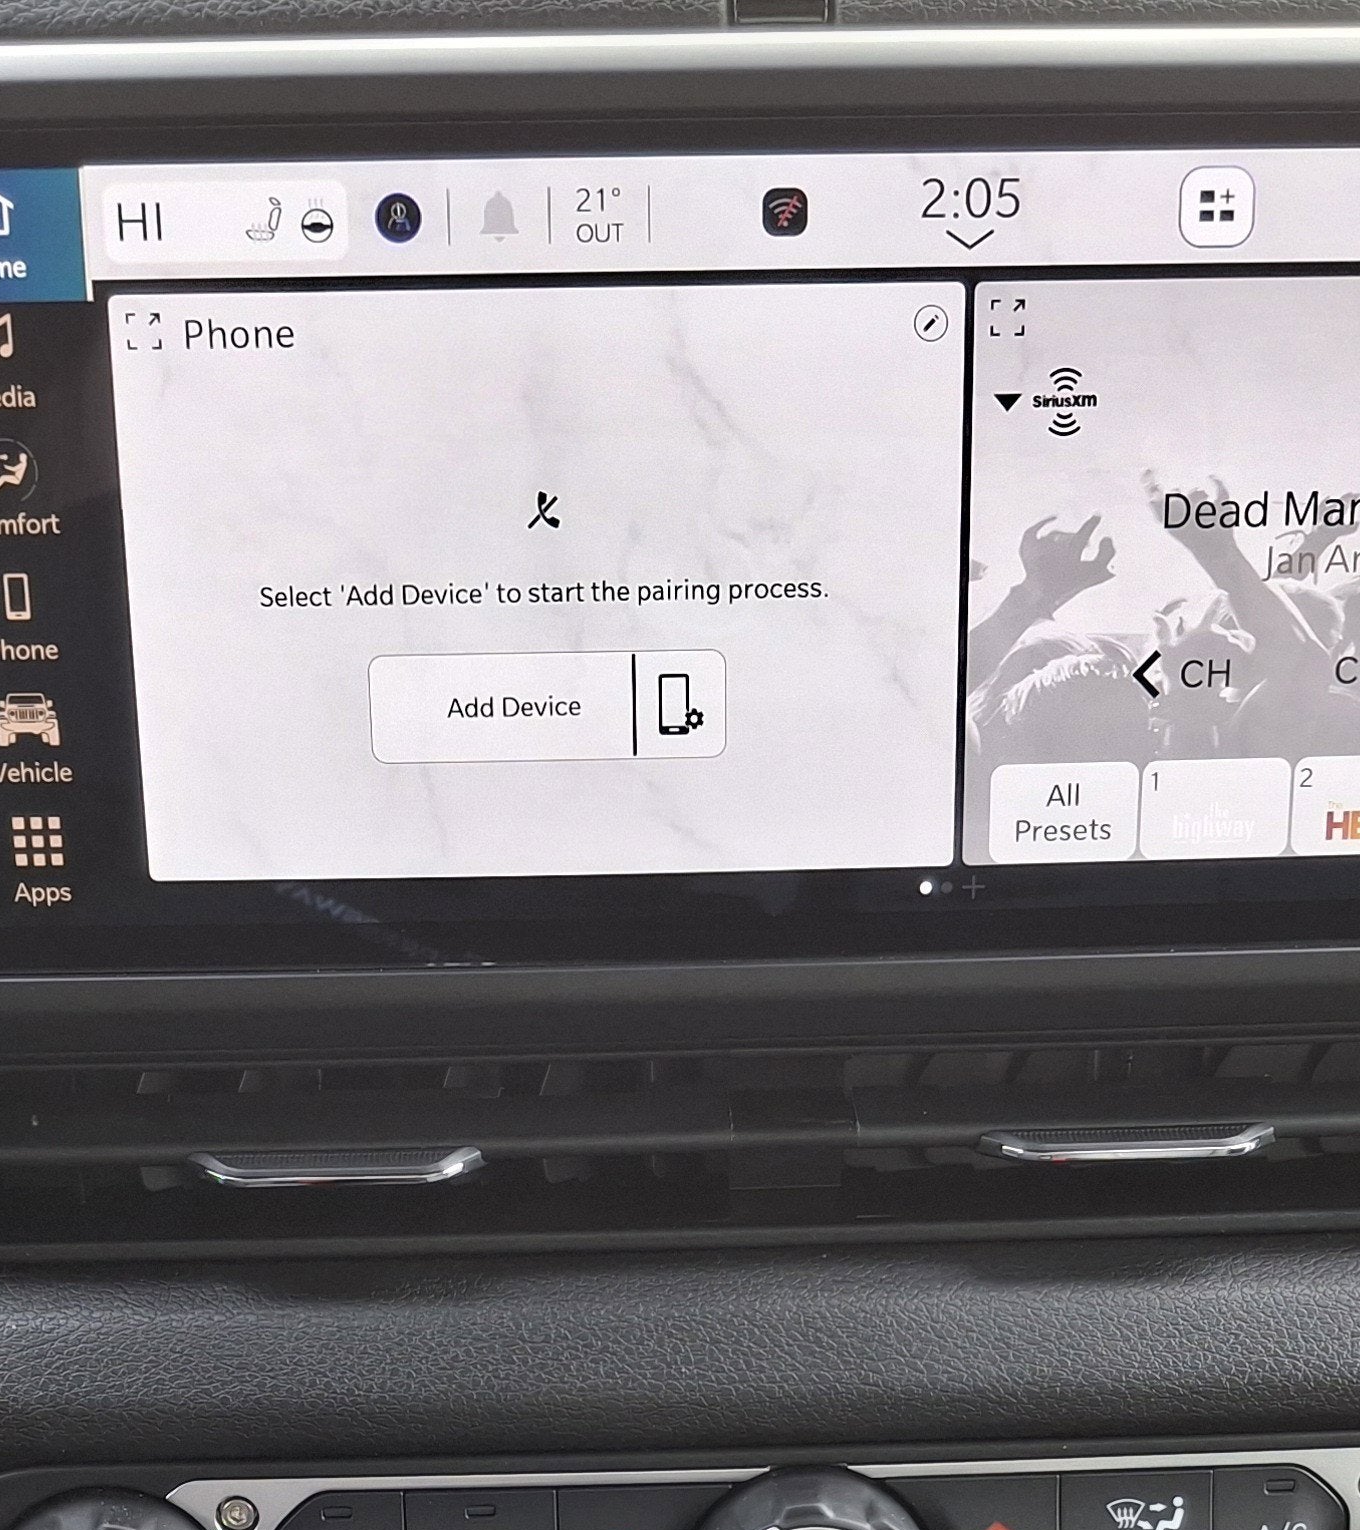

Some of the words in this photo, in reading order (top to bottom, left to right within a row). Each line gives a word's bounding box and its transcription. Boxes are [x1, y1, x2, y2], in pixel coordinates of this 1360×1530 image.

[922, 177, 1021, 220] 2:05
[118, 203, 163, 241] HI
[577, 223, 624, 243] OUT
[185, 320, 295, 349] Phone
[1163, 491, 1268, 529] Dead
[1263, 546, 1315, 580] Jan
[260, 585, 332, 608] Select
[340, 584, 396, 607] 'Add
[401, 582, 489, 605] Device'
[497, 583, 522, 603] to
[528, 582, 587, 603] start
[592, 580, 629, 602] the
[638, 579, 720, 607] pairing
[728, 580, 829, 604] process.
[1180, 659, 1231, 687] CH
[447, 697, 494, 719] Add
[502, 696, 581, 718] Device
[1152, 772, 1158, 791] 1
[1300, 768, 1313, 787] 2
[1047, 783, 1081, 808] All
[1015, 817, 1112, 845] Presets
[15, 882, 72, 905] Apps
